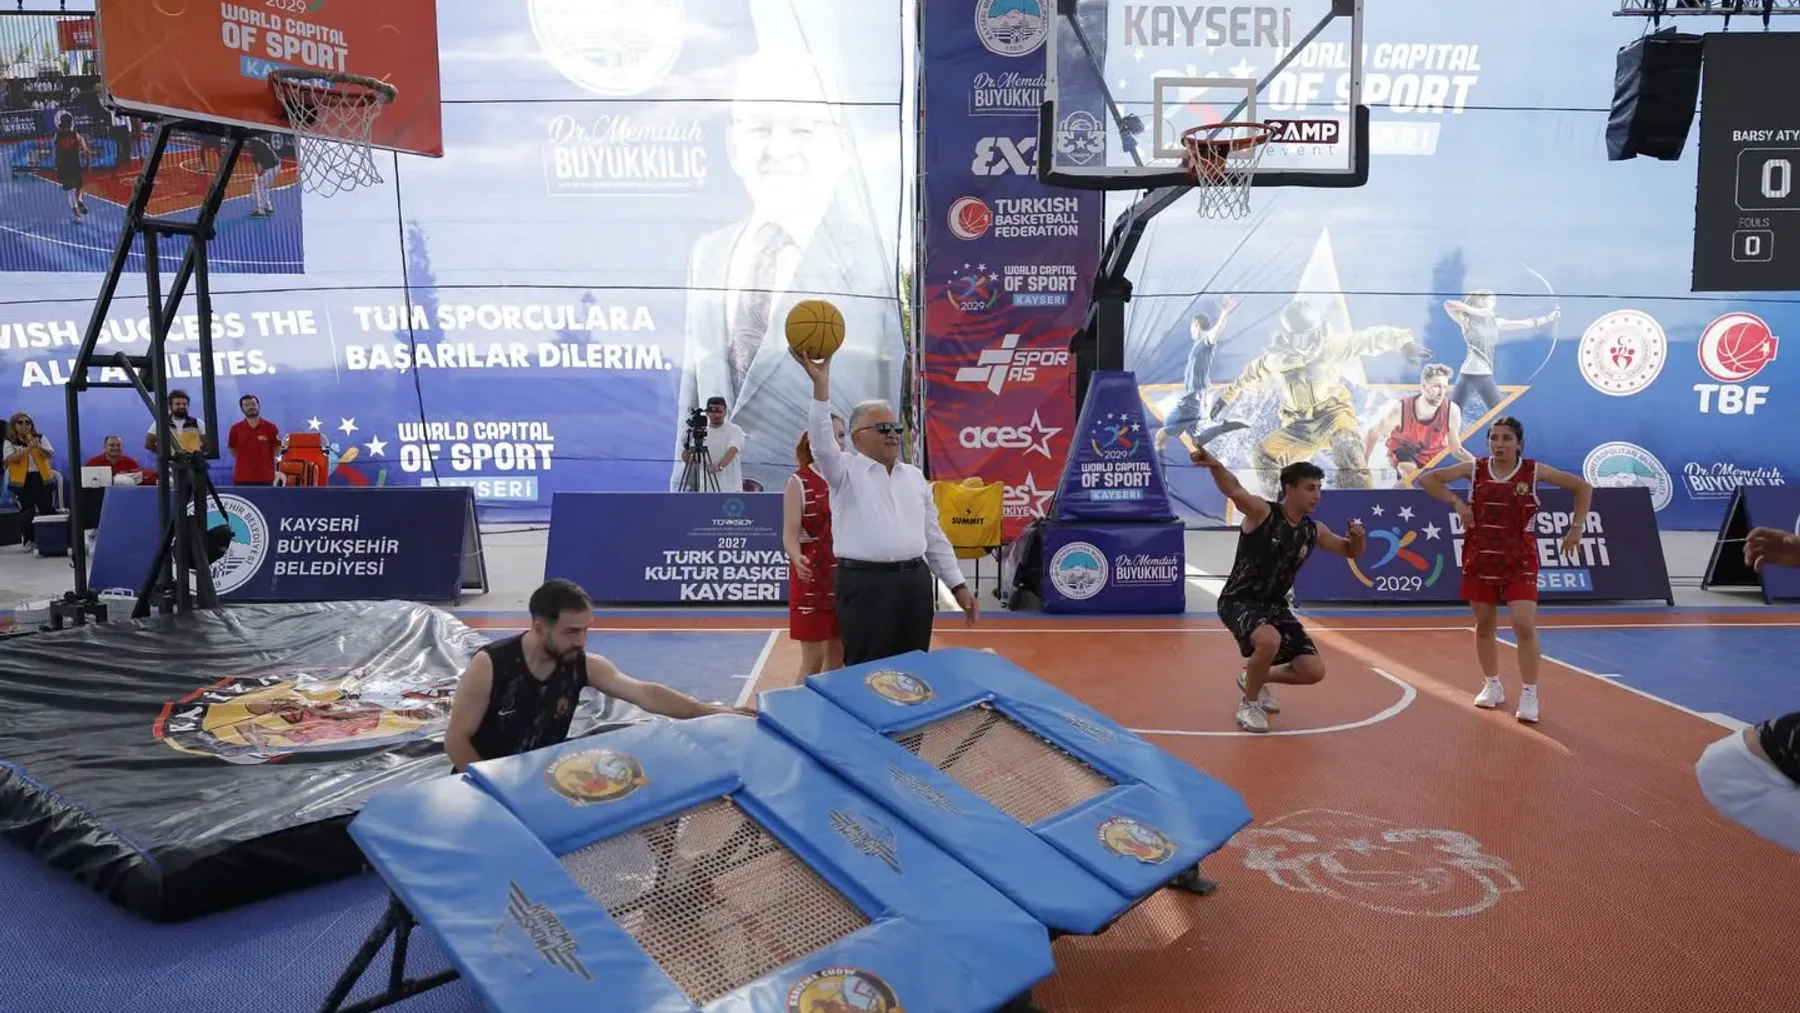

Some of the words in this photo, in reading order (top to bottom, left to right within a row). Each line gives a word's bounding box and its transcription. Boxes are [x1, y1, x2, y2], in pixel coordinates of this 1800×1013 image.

[221, 2, 281, 31] WORLD
[285, 18, 348, 47] CAPITAL
[222, 20, 257, 52] OF
[266, 31, 348, 73] SPORT
[1373, 43, 1482, 71] CAPITAL
[997, 71, 1047, 89] Memdu
[1268, 72, 1325, 112] OF
[1334, 73, 1480, 114] SPORT
[592, 115, 703, 146] Memduh
[1269, 121, 1337, 142] CAMP
[1733, 130, 1774, 142] BARSY
[1776, 130, 1800, 142] ATY
[1266, 145, 1335, 156] event
[1761, 159, 1792, 198] 0
[995, 197, 1078, 214] TURKISH
[995, 213, 1078, 226] BASKETBALL
[1739, 217, 1770, 227] FOULS
[995, 224, 1078, 238] FEDERATION
[1745, 236, 1760, 256] 0
[1004, 265, 1038, 275] WORLD
[1039, 265, 1077, 275] CAPITAL
[1004, 276, 1024, 291] OF
[1028, 276, 1077, 291] SPORT
[960, 301, 985, 311] 2029
[251, 310, 318, 337] THE
[437, 304, 656, 331] SPORCULARA
[100, 349, 277, 383] ALETES.
[345, 342, 530, 374] BAŞARILAR
[1014, 352, 1068, 366] SPOR
[1693, 383, 1770, 415] TBF
[397, 421, 469, 442] WORLD
[473, 421, 554, 441] CAPITAL
[959, 426, 1033, 449] aces
[400, 443, 441, 473] OF
[451, 442, 554, 471] SPORT
[1104, 449, 1128, 460] 2029
[1081, 462, 1114, 473] WORLD
[1115, 462, 1151, 472] CAPITAL
[1684, 462, 1708, 476] Dr.
[1081, 472, 1100, 488] OF
[1104, 472, 1152, 488] SPORT
[1003, 485, 1030, 506] es
[280, 514, 360, 532] KAYSERİ
[952, 517, 984, 526] SUMMIT
[277, 536, 399, 558] BÜYÜKŞEHİR
[718, 537, 747, 549] 2027
[718, 550, 790, 565] DÜNYAS
[274, 558, 384, 575] BELEDİYESİ
[723, 566, 789, 583] BAŞKE
[1375, 575, 1423, 592] 2029
